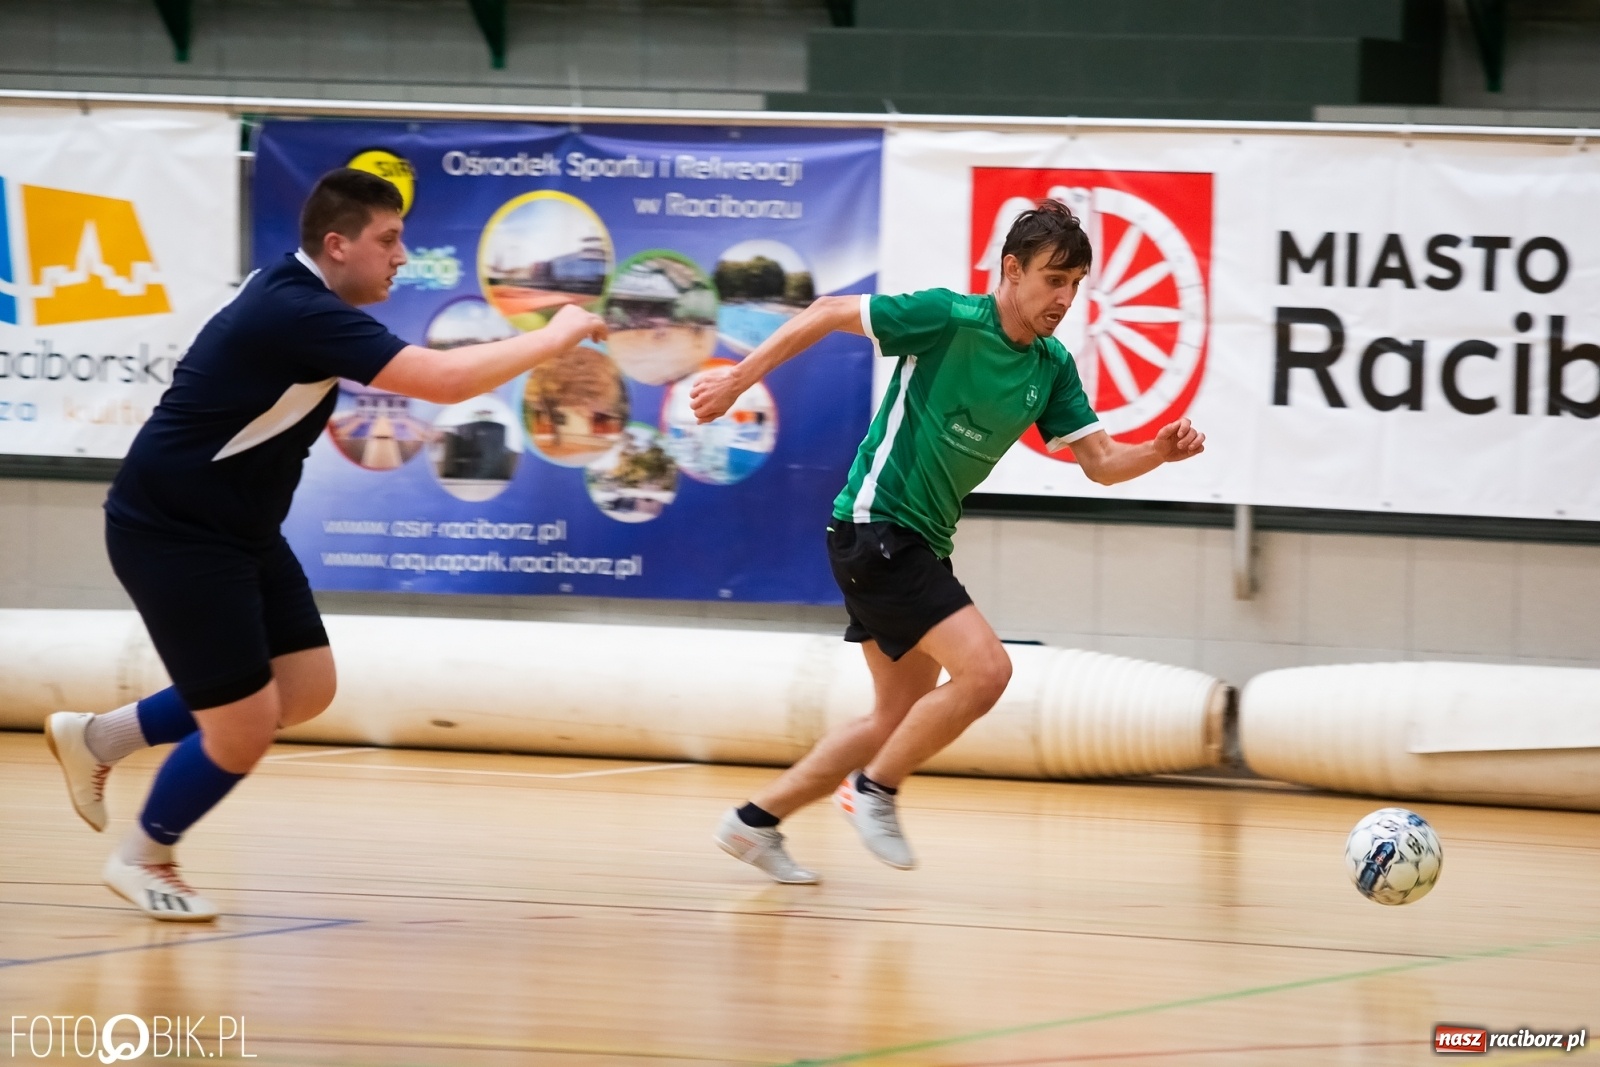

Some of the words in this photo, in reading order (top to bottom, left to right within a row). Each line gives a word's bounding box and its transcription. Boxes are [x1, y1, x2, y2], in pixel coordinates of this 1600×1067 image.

[442, 150, 562, 176] Ośrodek
[566, 151, 655, 182] Sportu
[659, 155, 671, 178] i
[675, 154, 802, 187] Rekreacji
[633, 197, 662, 215] w
[665, 192, 803, 219] Raciborzu
[1277, 229, 1569, 295] MIASTO
[1271, 306, 1600, 419] Racib
